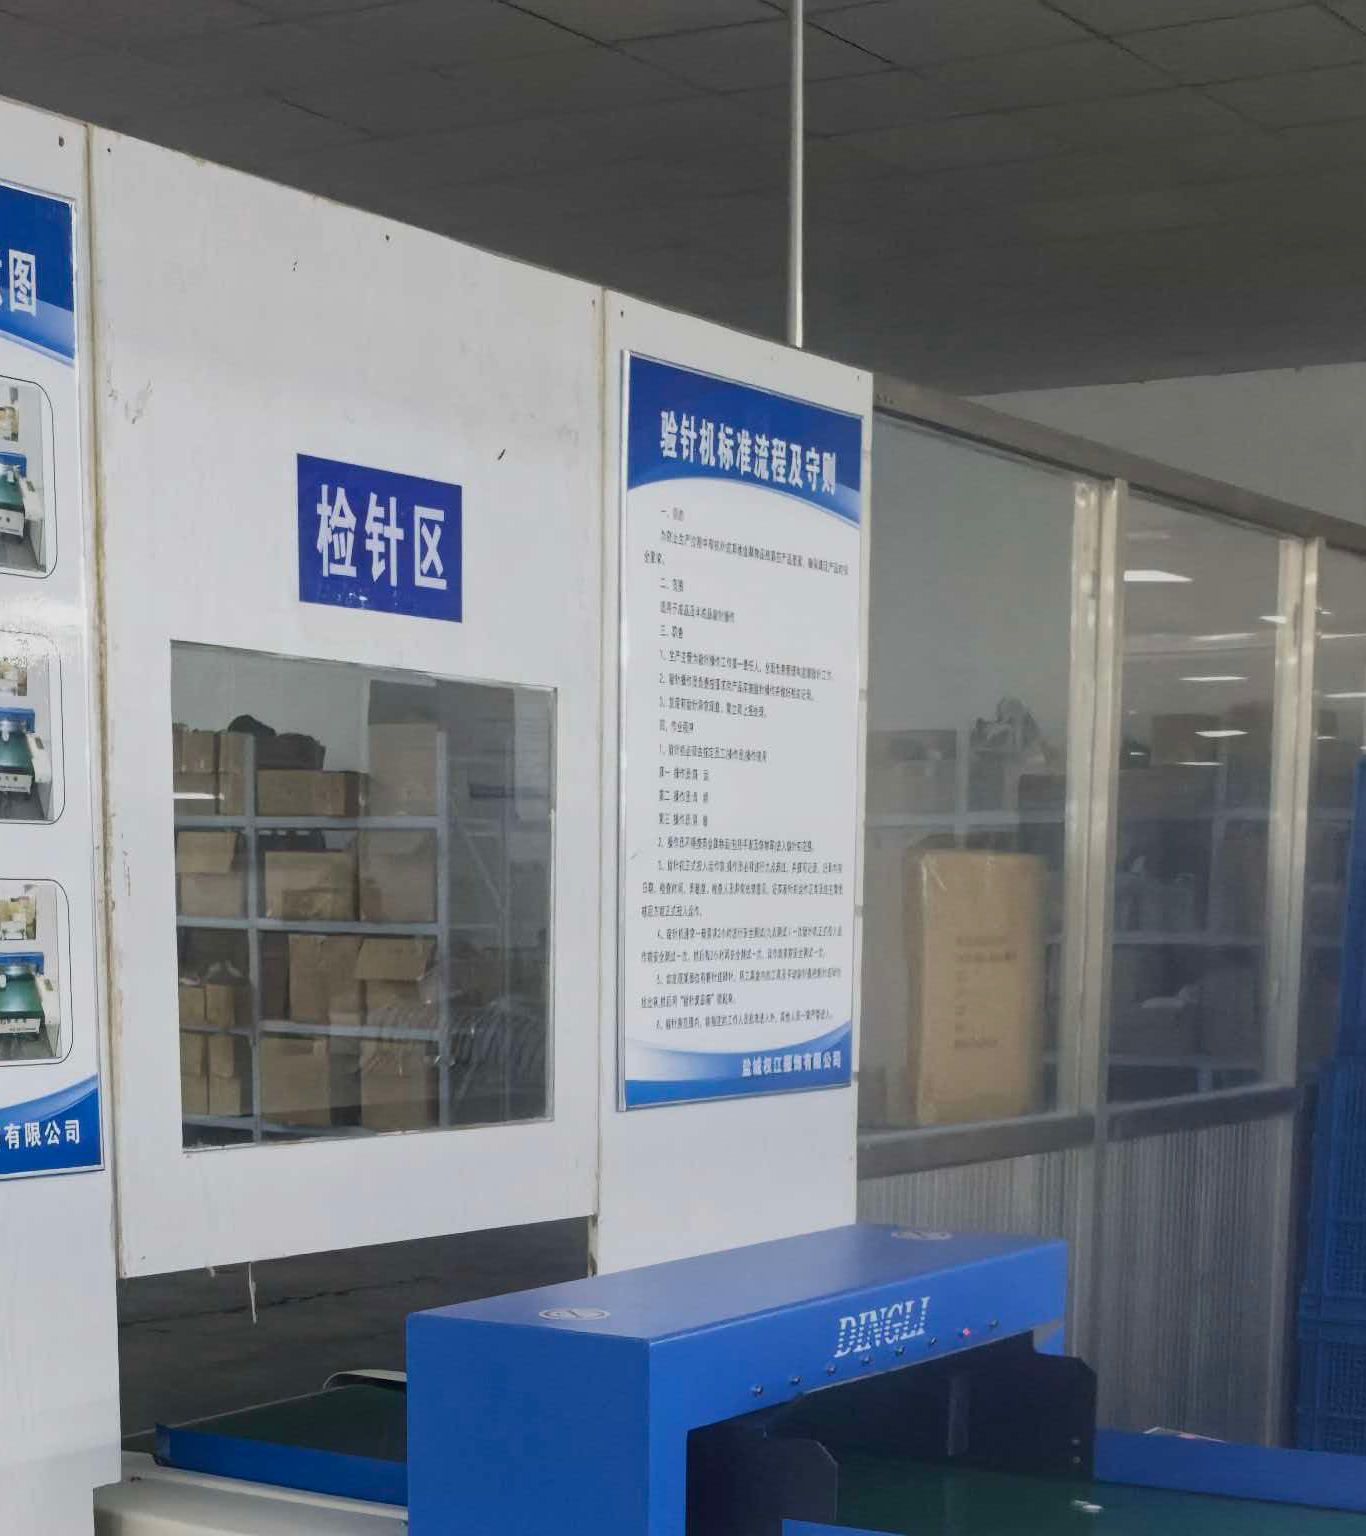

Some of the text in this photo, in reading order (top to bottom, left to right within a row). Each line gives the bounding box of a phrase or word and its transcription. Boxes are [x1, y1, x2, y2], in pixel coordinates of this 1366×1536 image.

[660, 410, 836, 496] 验针机标准流程及守则
[316, 483, 448, 591] 检针区
[833, 1296, 931, 1359] DINGLI
